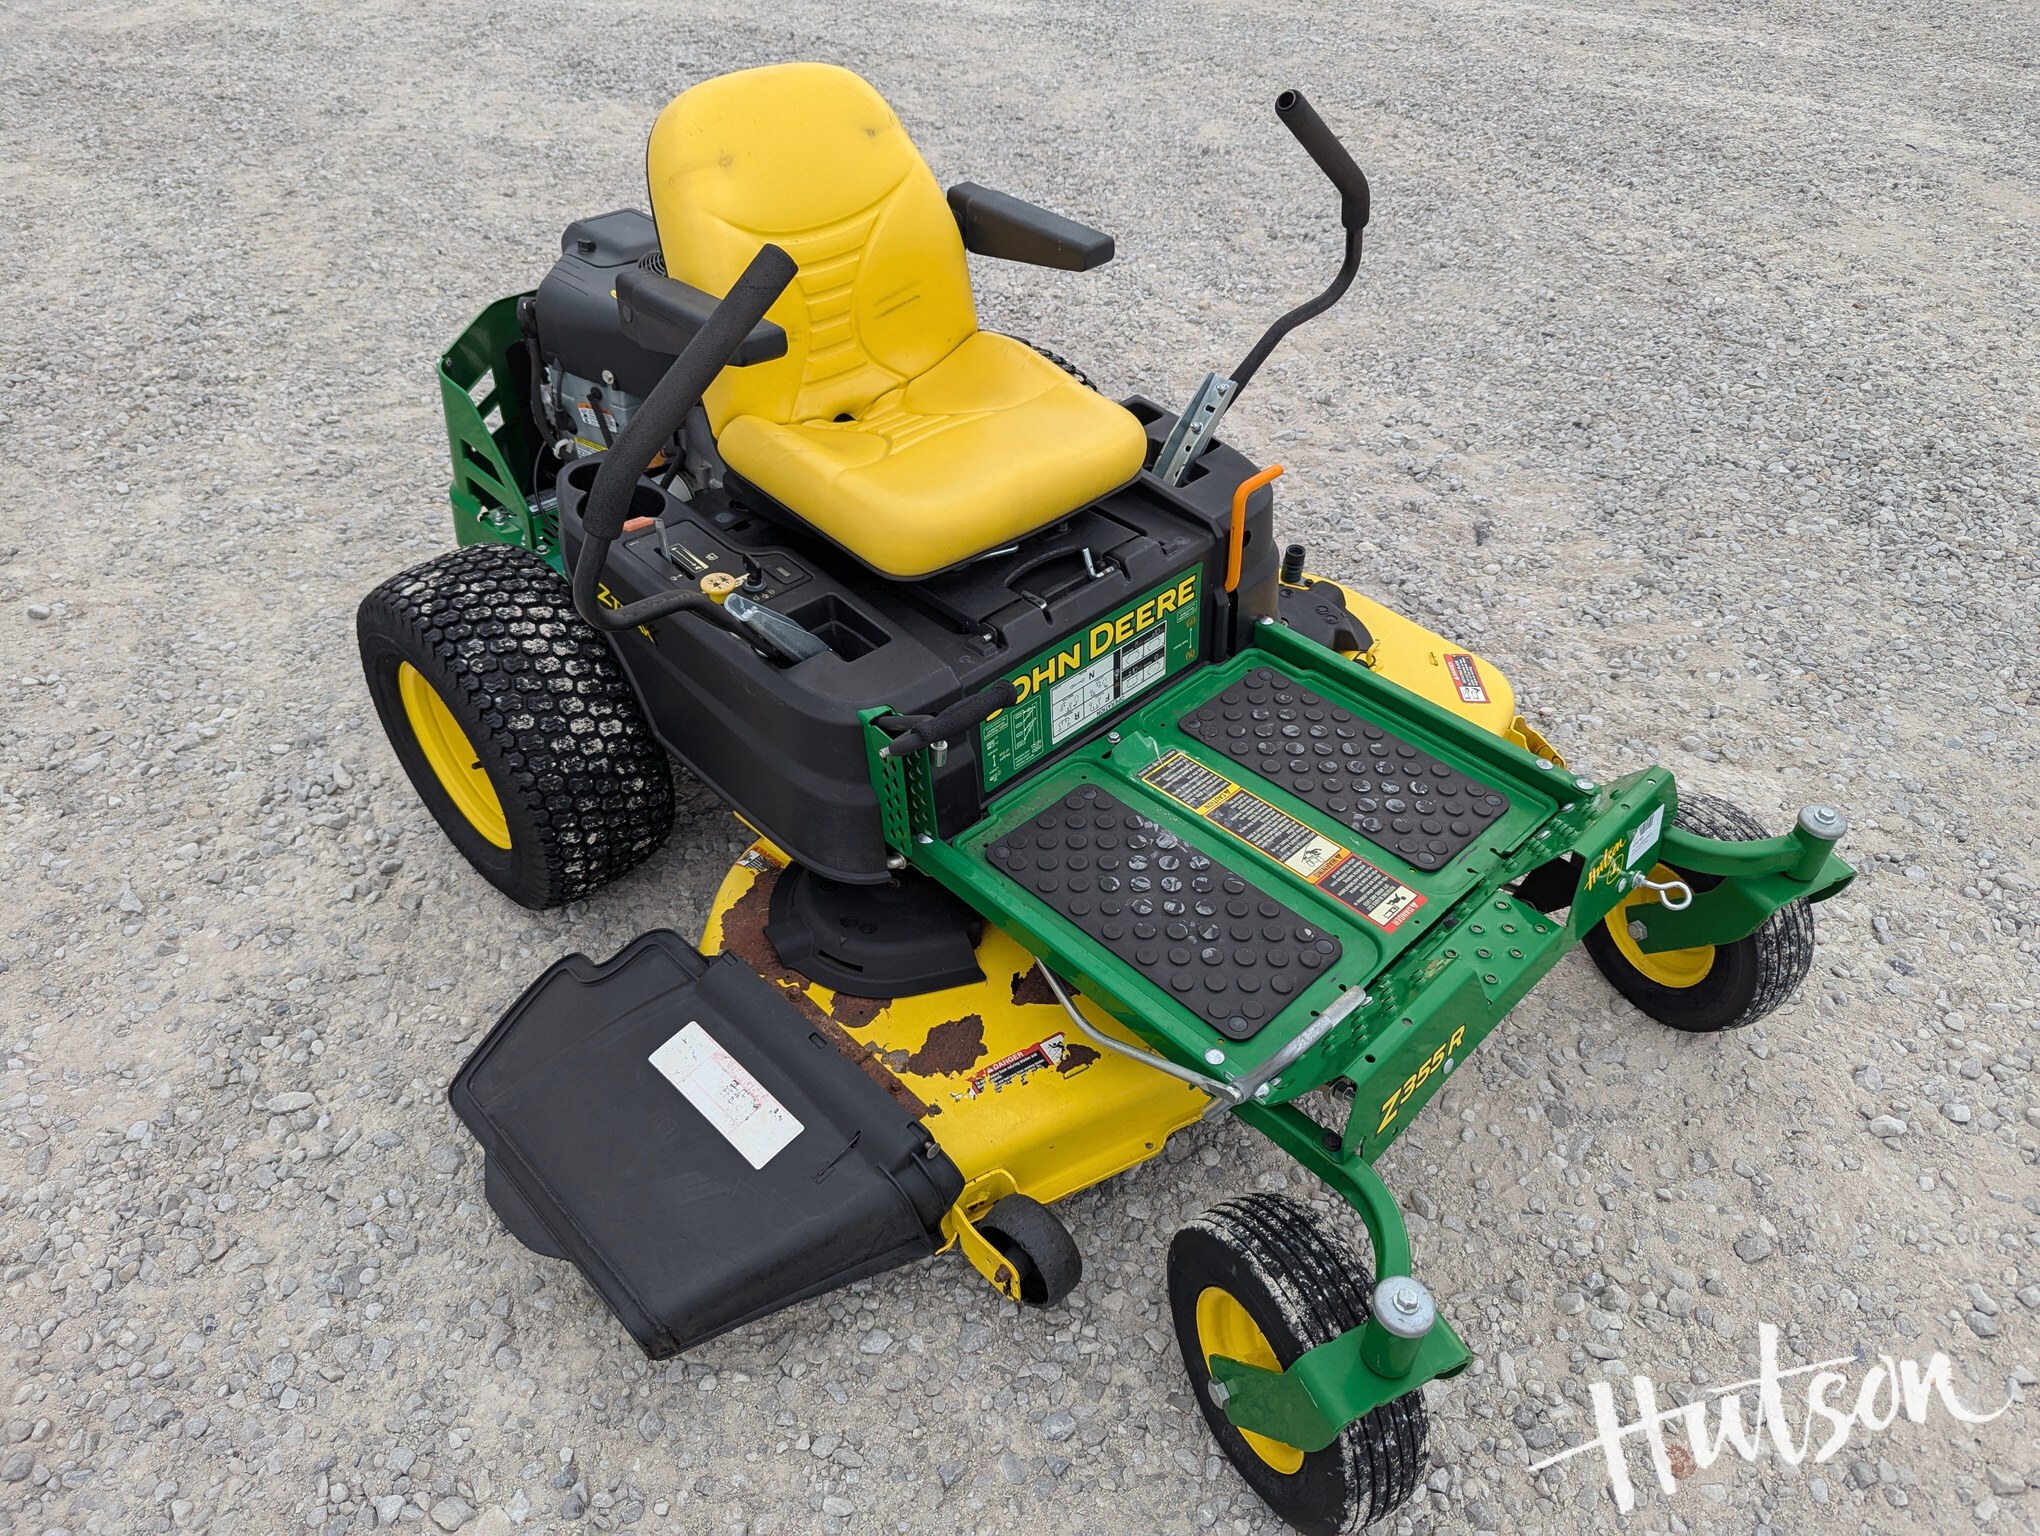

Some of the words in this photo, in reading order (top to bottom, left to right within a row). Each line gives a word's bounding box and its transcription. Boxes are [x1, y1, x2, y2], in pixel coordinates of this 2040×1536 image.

[986, 643, 1081, 722] OHN
[1090, 575, 1196, 660] DEERE
[1088, 670, 1095, 680] N
[1096, 695, 1126, 717] OPERATION
[1105, 692, 1110, 702] F
[1074, 711, 1080, 720] R
[1203, 792, 1226, 809] CAUTION
[1312, 858, 1338, 878] WARNING
[1390, 905, 1415, 926] DANGER
[993, 1052, 1024, 1070] DANGER
[1376, 1024, 1466, 1134] Z355R
